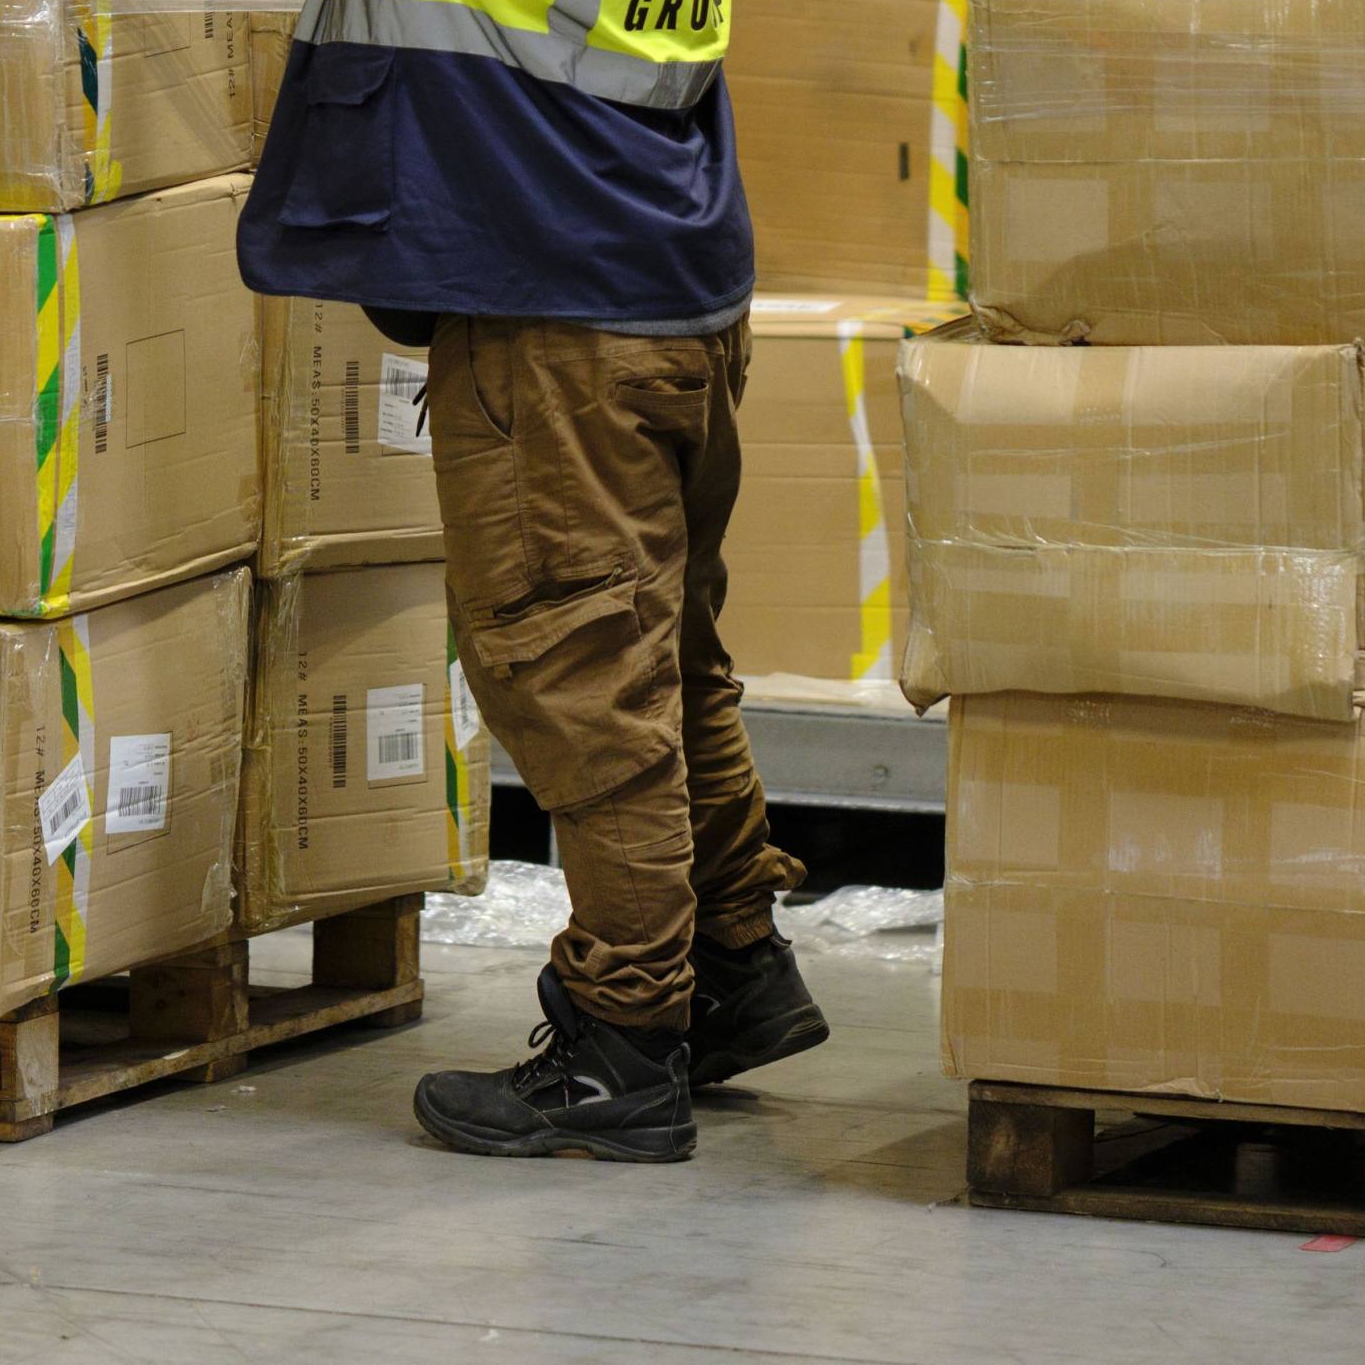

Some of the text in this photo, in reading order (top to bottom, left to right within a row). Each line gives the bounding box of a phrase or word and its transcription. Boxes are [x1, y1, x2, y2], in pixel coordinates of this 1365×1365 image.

[309, 345, 322, 502] MEAS:50X40X60CM
[298, 650, 309, 850] 12# MEAS:50X40X60CM
